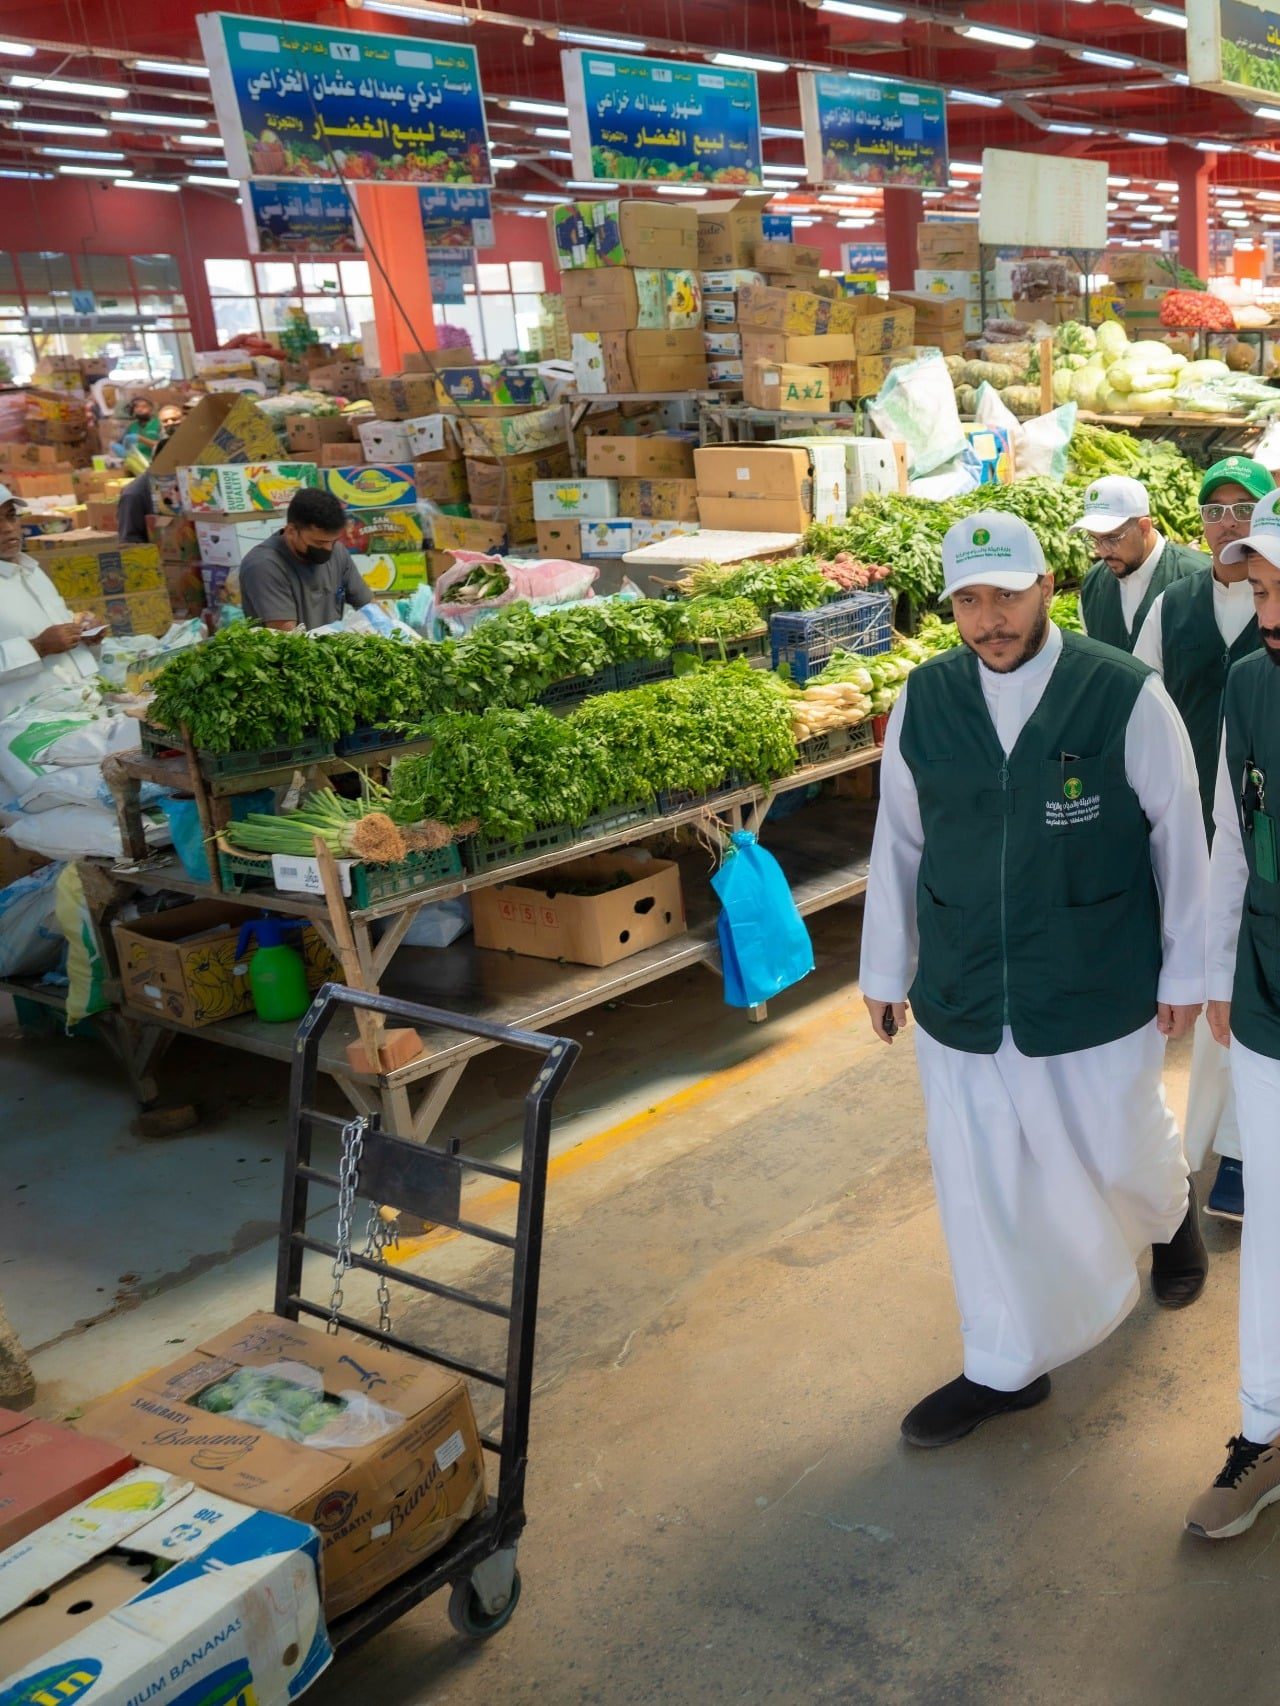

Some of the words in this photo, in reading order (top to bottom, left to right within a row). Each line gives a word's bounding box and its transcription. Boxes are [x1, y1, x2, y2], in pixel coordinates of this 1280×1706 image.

[247, 67, 309, 101] الخزاعي
[313, 71, 355, 100] عثمان
[408, 81, 442, 113] تركي
[312, 114, 389, 140] الخضار
[392, 121, 435, 150] لبيع
[634, 126, 686, 148] الخضار
[693, 133, 724, 155] لبيع
[223, 471, 236, 510] SUPERIOR
[231, 471, 246, 510] QUALITY
[142, 1427, 261, 1451] Bananas
[169, 1618, 243, 1682] BANANAS
